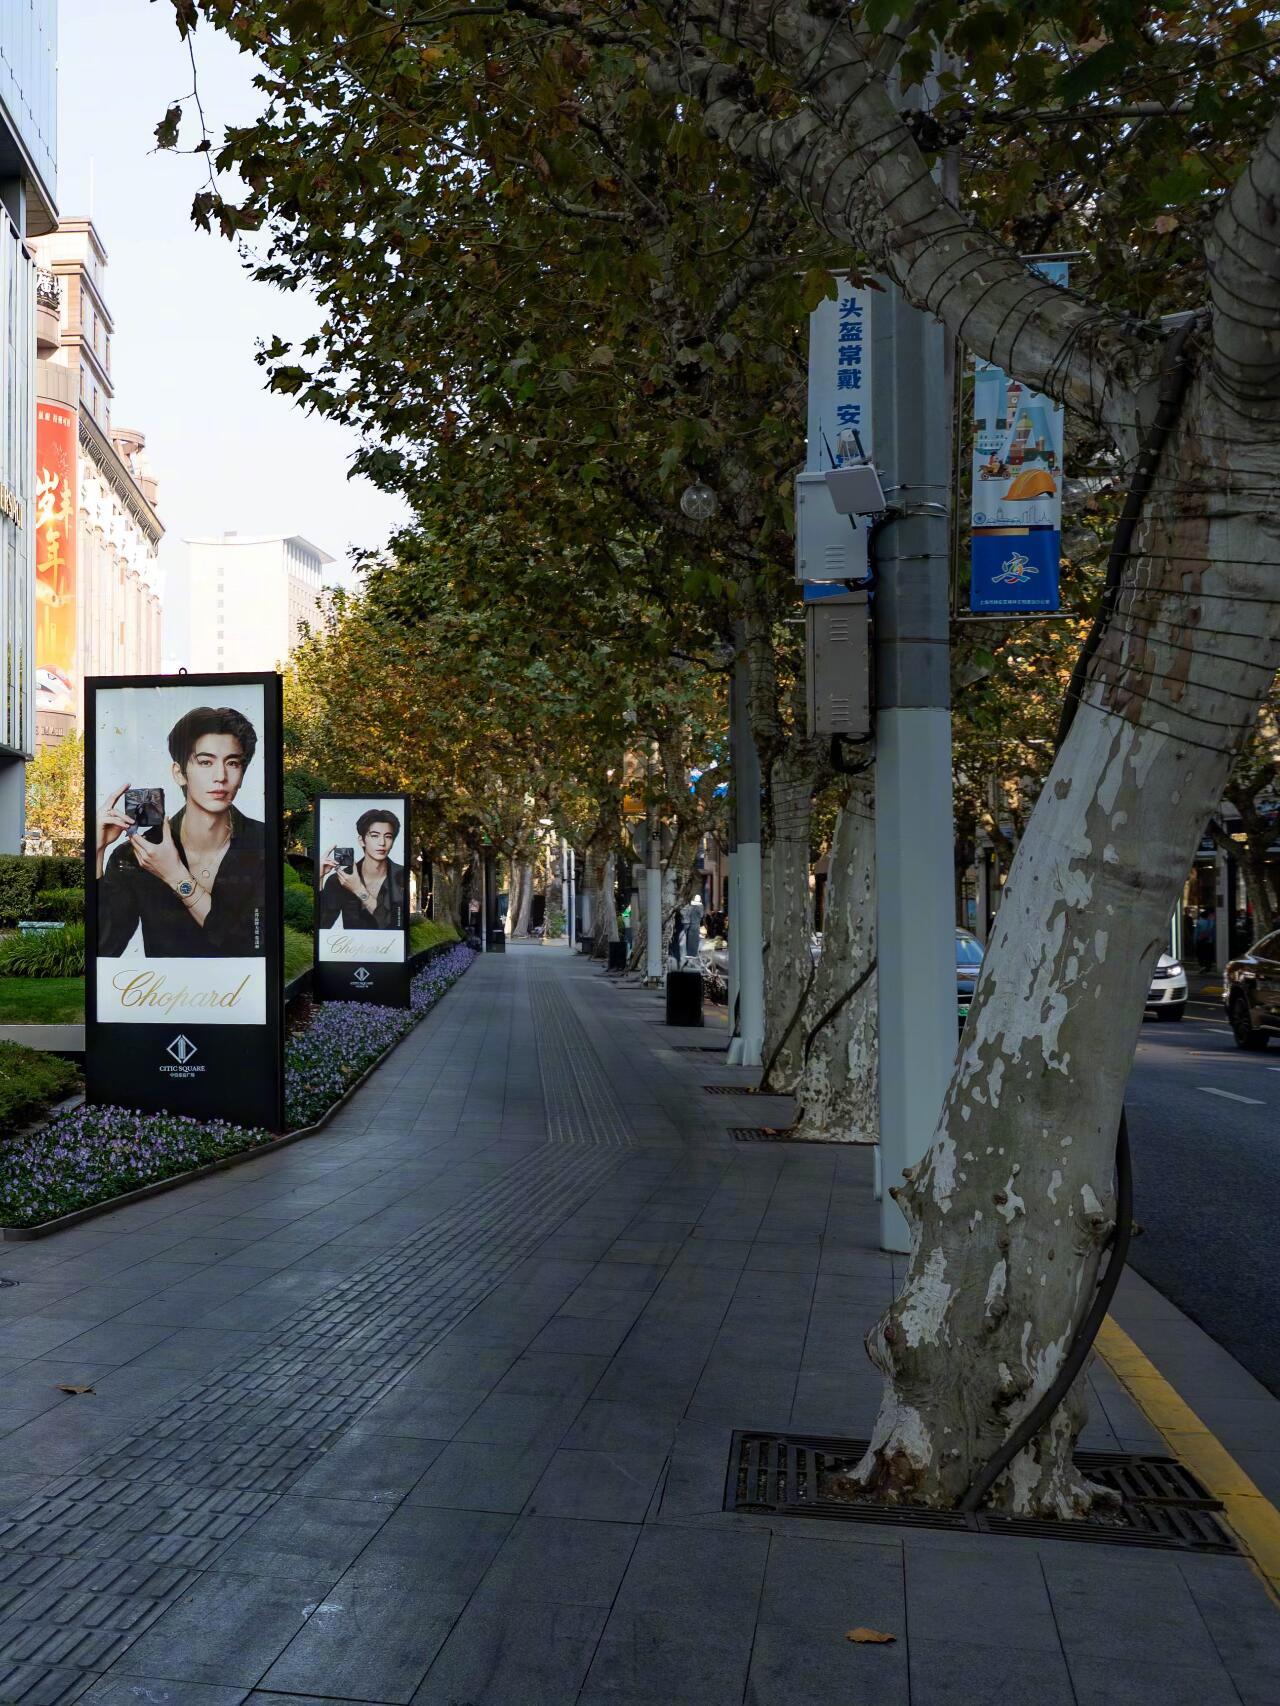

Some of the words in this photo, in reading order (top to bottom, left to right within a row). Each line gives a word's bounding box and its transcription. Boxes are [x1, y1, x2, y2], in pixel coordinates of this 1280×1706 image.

[837, 297, 863, 390] 头盔常戴
[326, 935, 396, 957] Chopard
[113, 969, 252, 1016] Chopard
[178, 1065, 206, 1073] SQUARE
